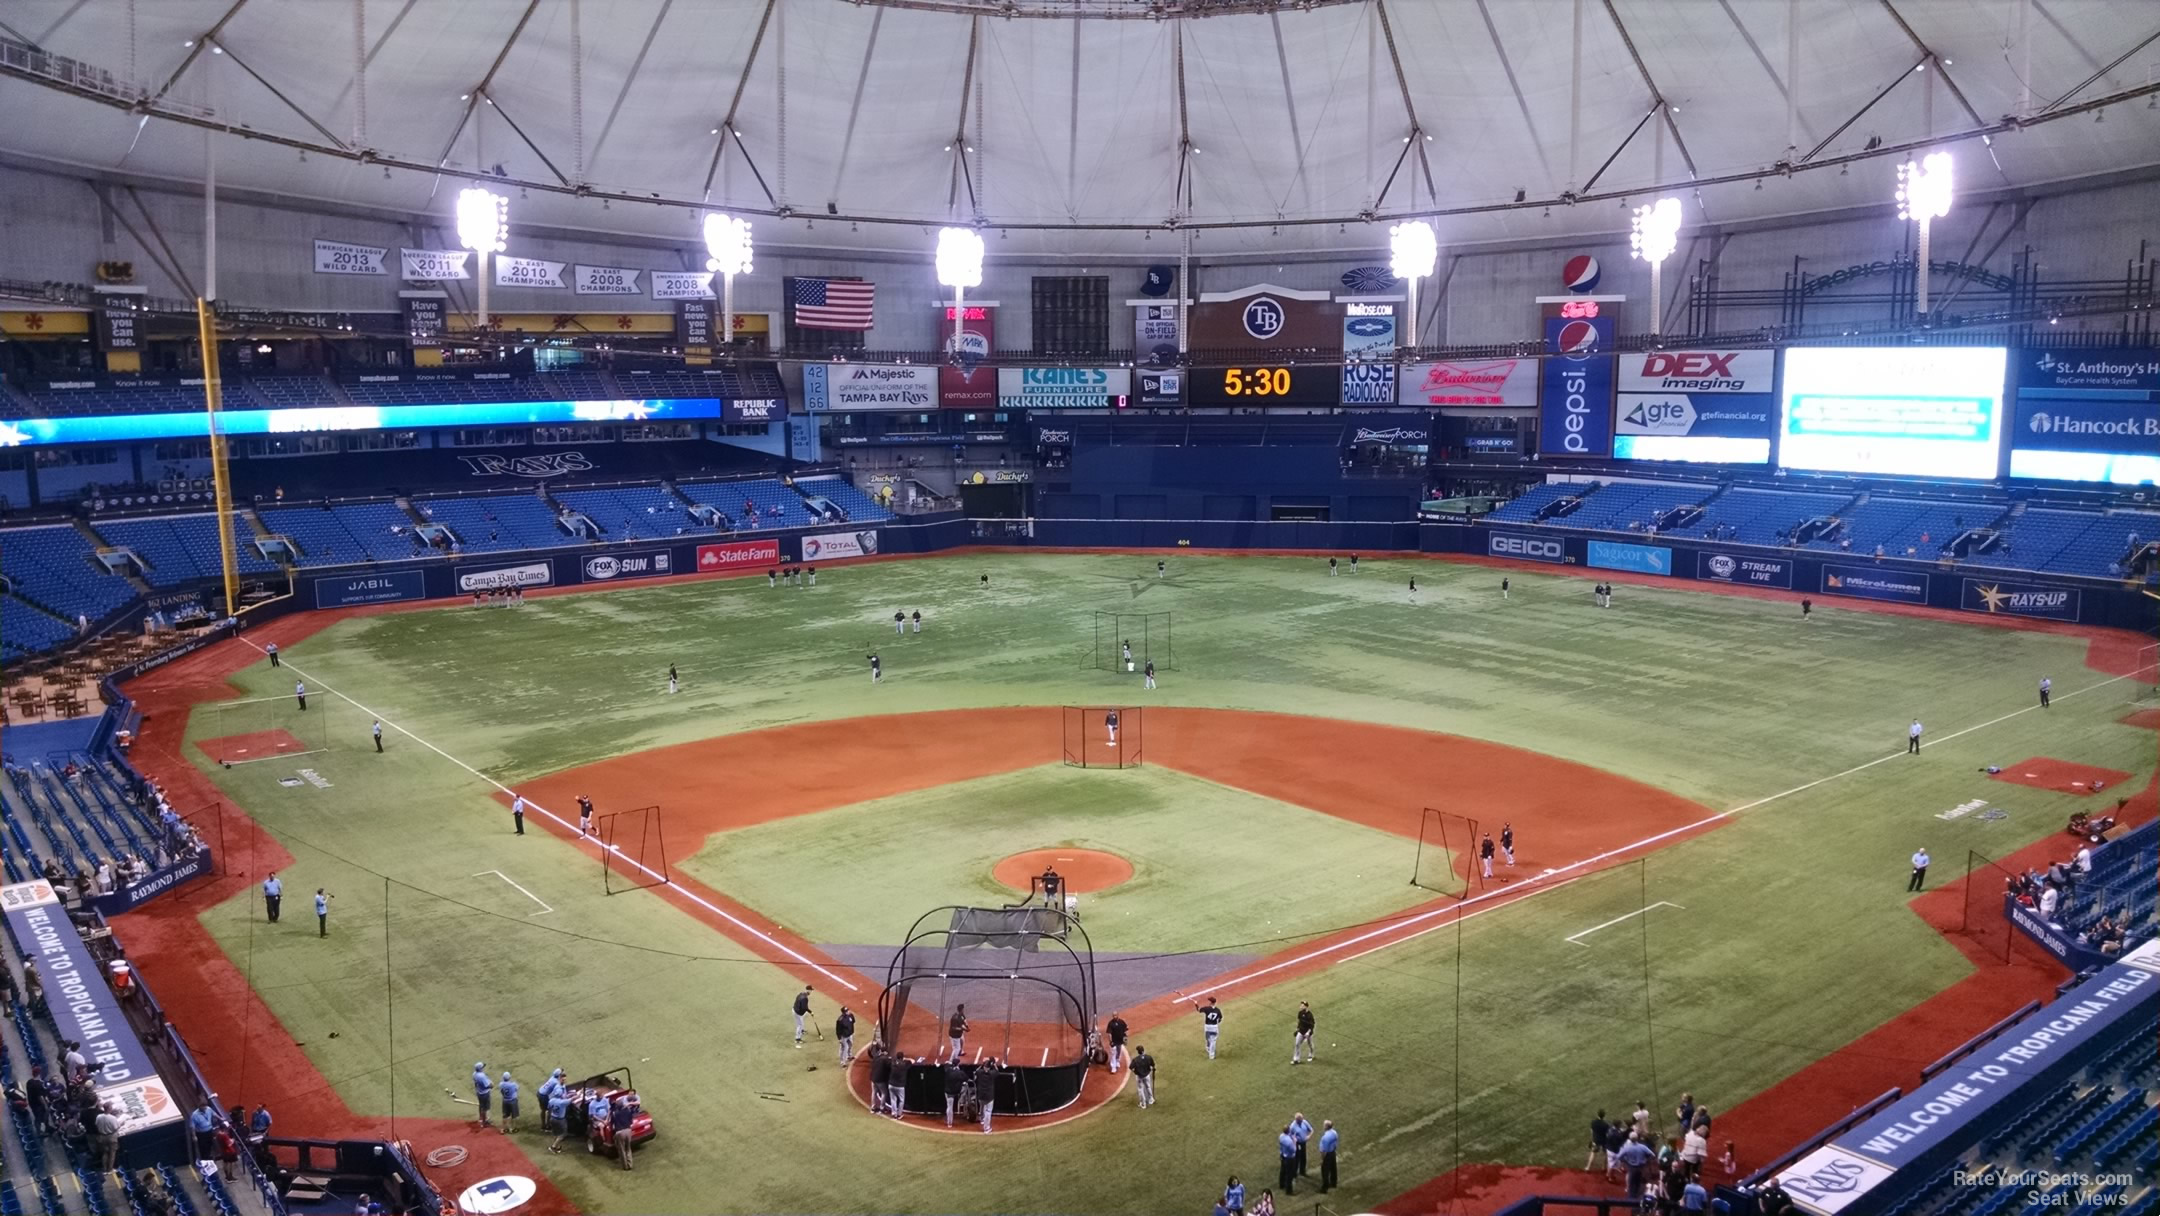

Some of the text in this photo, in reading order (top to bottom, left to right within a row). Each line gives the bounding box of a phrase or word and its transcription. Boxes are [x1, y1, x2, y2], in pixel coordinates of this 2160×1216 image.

[317, 244, 382, 256] AMERICAN LEAGUE
[333, 252, 369, 265] 2013
[323, 263, 377, 273] WILD CARD
[418, 259, 450, 270] 2011
[435, 270, 460, 278] CARD
[512, 266, 547, 278] 2010
[501, 276, 557, 286] CHAMPIONS
[590, 274, 624, 285] 2008
[666, 280, 698, 289] 2008
[580, 285, 632, 293] CHAMPIONS
[656, 289, 708, 297] CHAMPIONS
[412, 301, 438, 310] Have
[416, 312, 436, 321] you
[1250, 306, 1278, 331] TB
[112, 319, 133, 330] you
[688, 320, 706, 329] you
[112, 328, 133, 337] can
[1145, 327, 1177, 335] ON-FIELD
[112, 338, 136, 346] use.
[1641, 353, 1740, 377] DEX
[2057, 362, 2160, 377] St. Anthony's H
[808, 367, 823, 378] 42
[870, 369, 915, 381] Majestic
[1344, 364, 1393, 382] ROSE
[1225, 368, 1291, 396] 5:30
[1662, 378, 1745, 390] imaging
[2056, 376, 2085, 385] BayCare
[810, 382, 821, 393] 12
[1344, 382, 1393, 402] RADIOLOGY
[840, 393, 900, 403] TAMPA BAY
[944, 391, 992, 400] remax.com
[733, 400, 776, 409] REPUBLIC
[809, 397, 824, 409] 66
[743, 408, 769, 416] BANK
[1562, 371, 1590, 452] pepsi
[1648, 401, 1684, 422] gte
[1701, 411, 1767, 422] gtefinancial.org
[2053, 416, 2141, 435] Hancock
[1040, 434, 1070, 442] PORCH
[1396, 431, 1427, 439] PORCH
[457, 452, 593, 477] RAYS
[871, 474, 901, 485] Ducky's
[996, 471, 1029, 482] Ducky's
[824, 542, 857, 550] TOTAL
[1492, 536, 1561, 557] GEICO
[1594, 543, 1642, 562] Sagicor
[594, 561, 614, 571] FOX
[622, 558, 647, 572] SUN
[1715, 559, 1730, 567] FOX
[1741, 562, 1781, 573] STREAM
[465, 571, 545, 587] Tampa Bay Times
[1751, 572, 1771, 581] LIVE
[348, 579, 393, 590] JABIL
[1846, 577, 1921, 591] MicroLumen
[162, 592, 200, 605] LANDING
[2047, 593, 2067, 605] UP
[131, 861, 199, 902] RAYMOND JAMES
[24, 907, 66, 956] WELCOME
[2013, 908, 2066, 957] RAYMOND JAMES
[48, 954, 73, 970] TO
[56, 969, 108, 1040] TROPICANA
[1208, 1012, 1218, 1020] 47
[90, 1039, 131, 1082] FIELD
[1860, 968, 2152, 1155] WELCOME TO TROPICANA FIELD
[1783, 1159, 1865, 1203] RAYS
